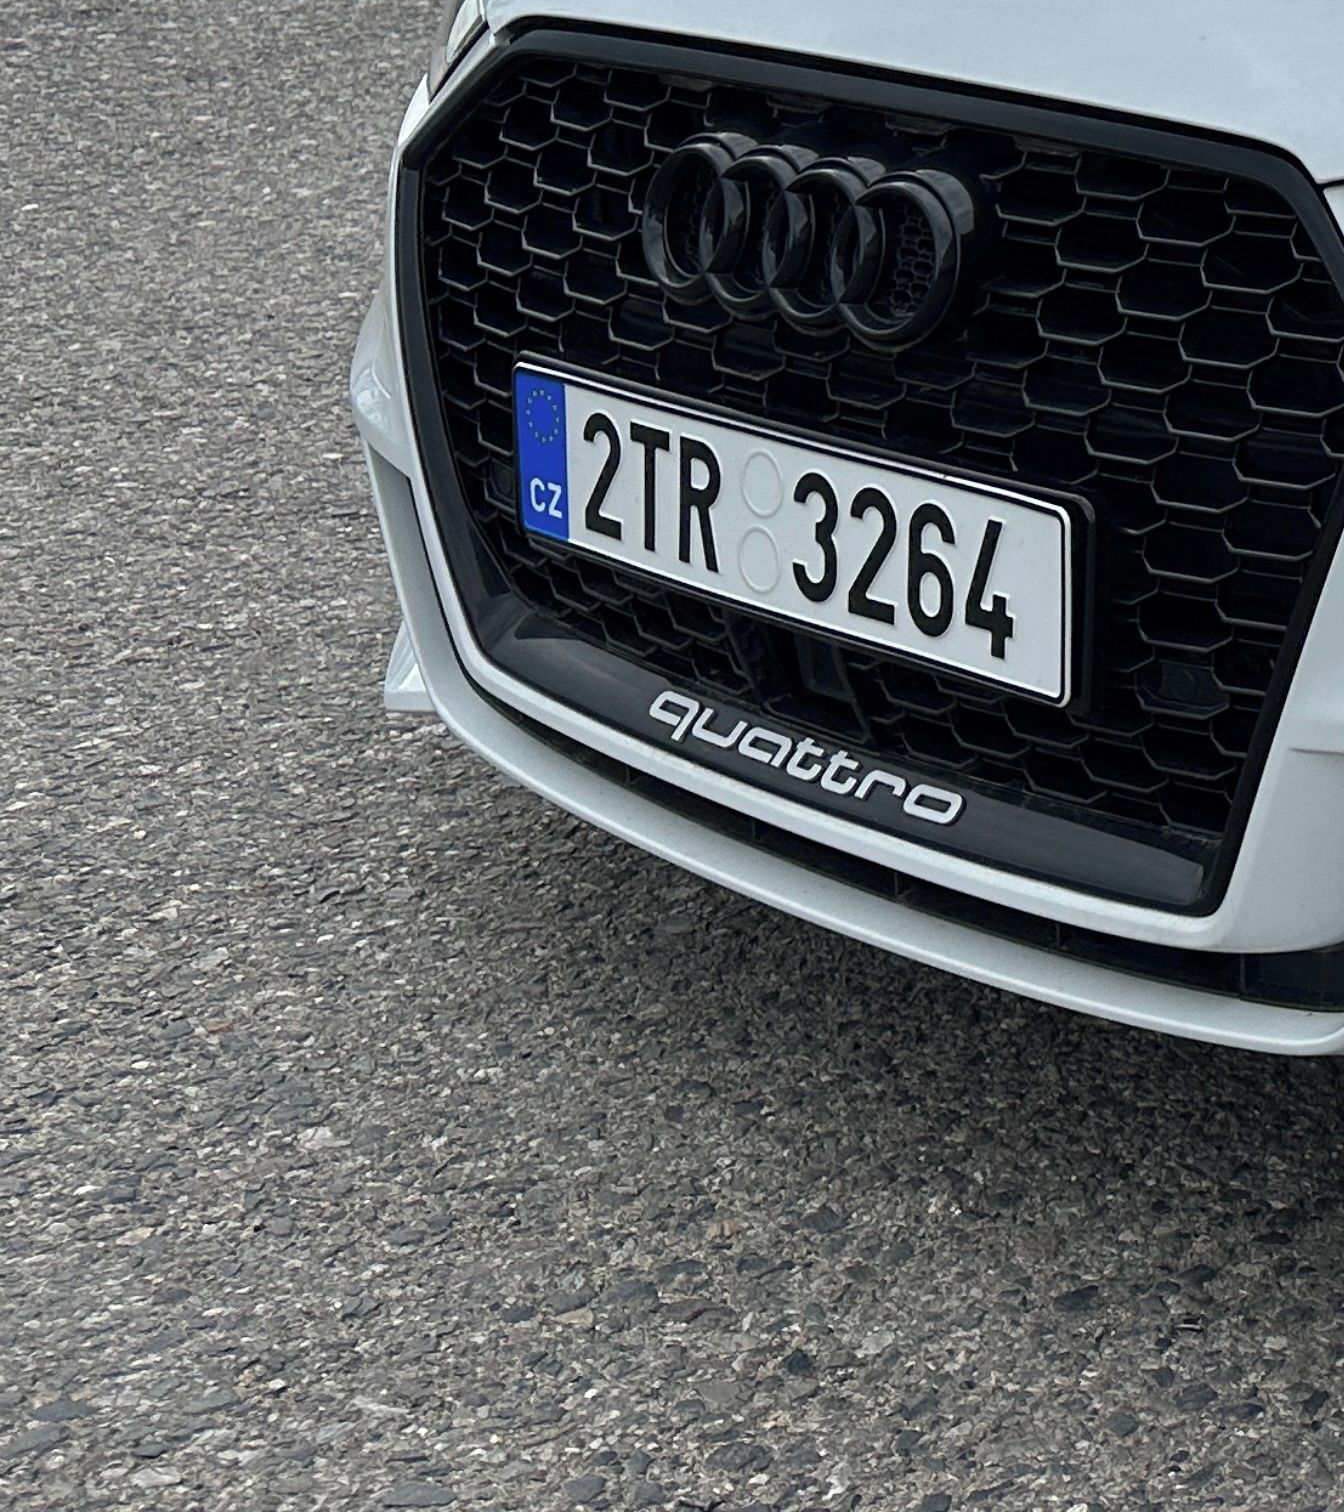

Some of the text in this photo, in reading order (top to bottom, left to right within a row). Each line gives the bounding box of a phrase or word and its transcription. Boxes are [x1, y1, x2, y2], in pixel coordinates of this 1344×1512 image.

[530, 477, 563, 519] CZ
[583, 411, 1014, 659] 2TR 3264
[648, 690, 964, 826] quattro
